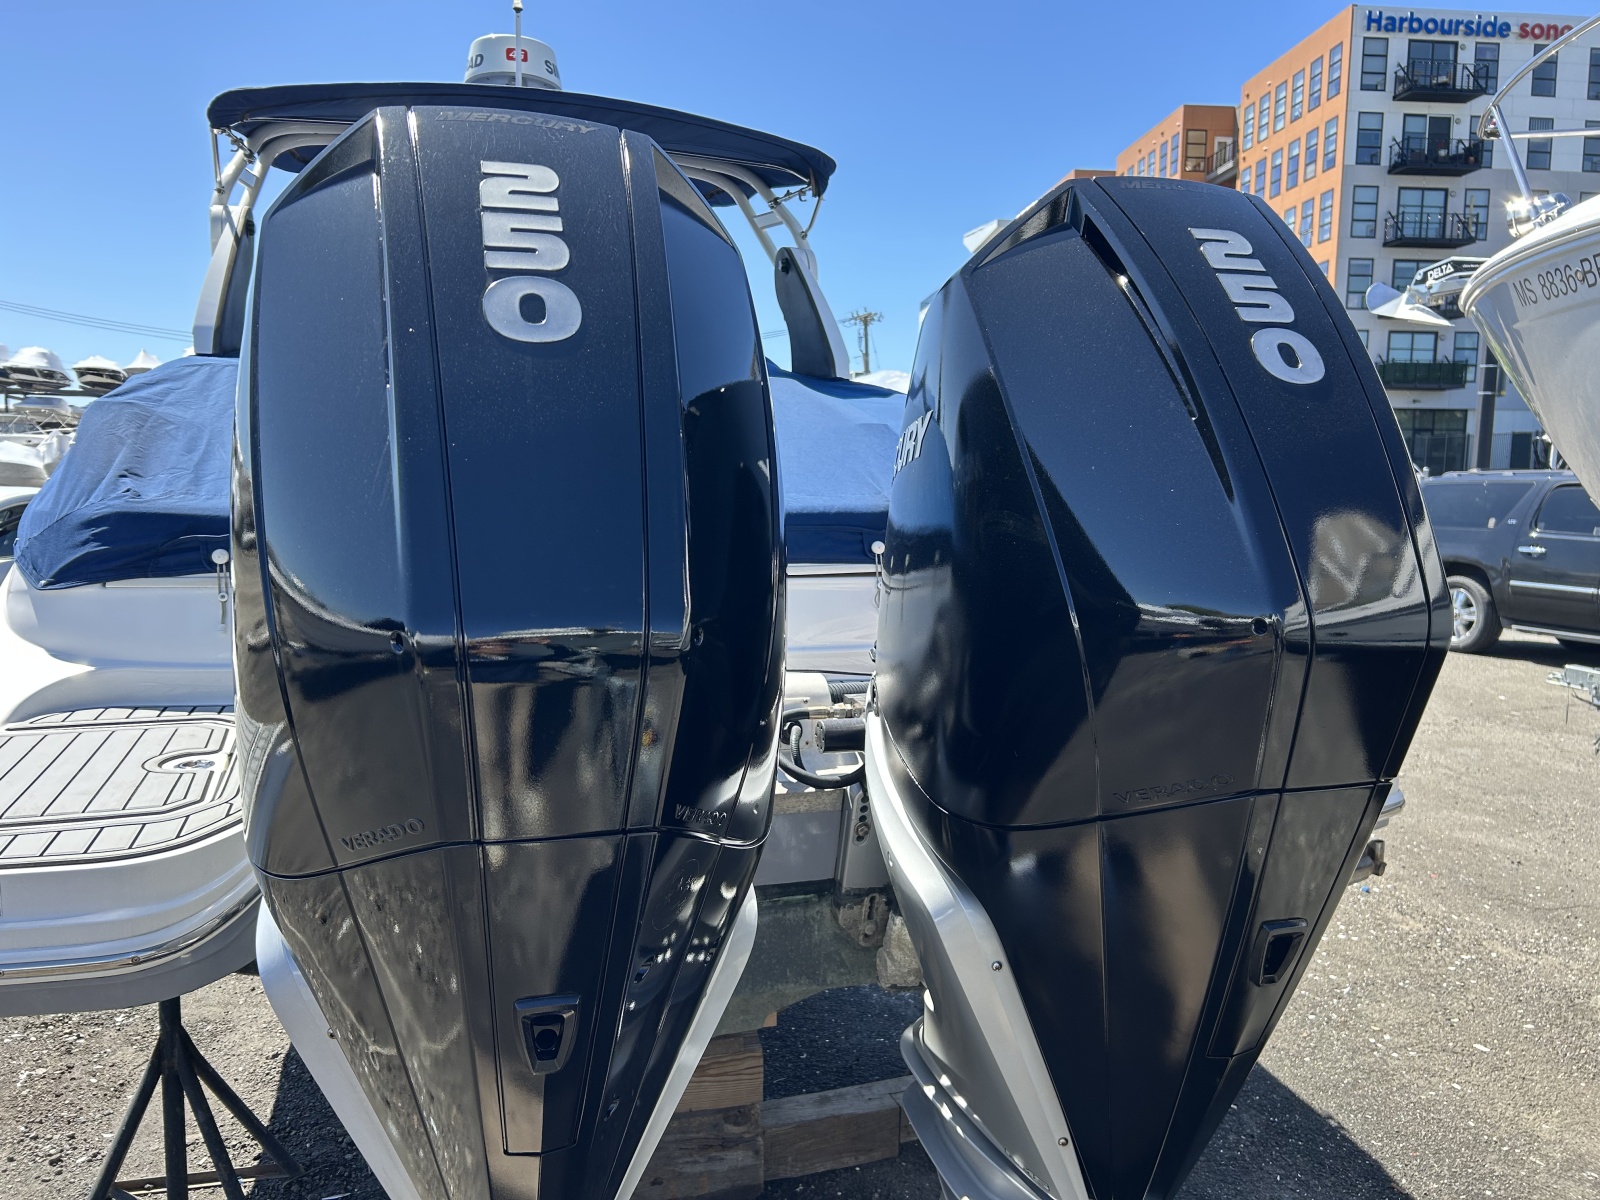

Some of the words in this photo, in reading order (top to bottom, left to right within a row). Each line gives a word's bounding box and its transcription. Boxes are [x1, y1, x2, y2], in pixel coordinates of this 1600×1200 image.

[1366, 10, 1511, 38] Harbourside
[435, 111, 601, 134] MERCURY
[479, 160, 582, 343] 250
[1427, 262, 1455, 281] DELTA
[1512, 278, 1538, 308] MS
[1537, 264, 1578, 301] 8836
[1188, 227, 1326, 385] 250
[893, 409, 934, 479] URY
[1112, 773, 1234, 804] VERADO
[339, 817, 425, 853] VERADO
